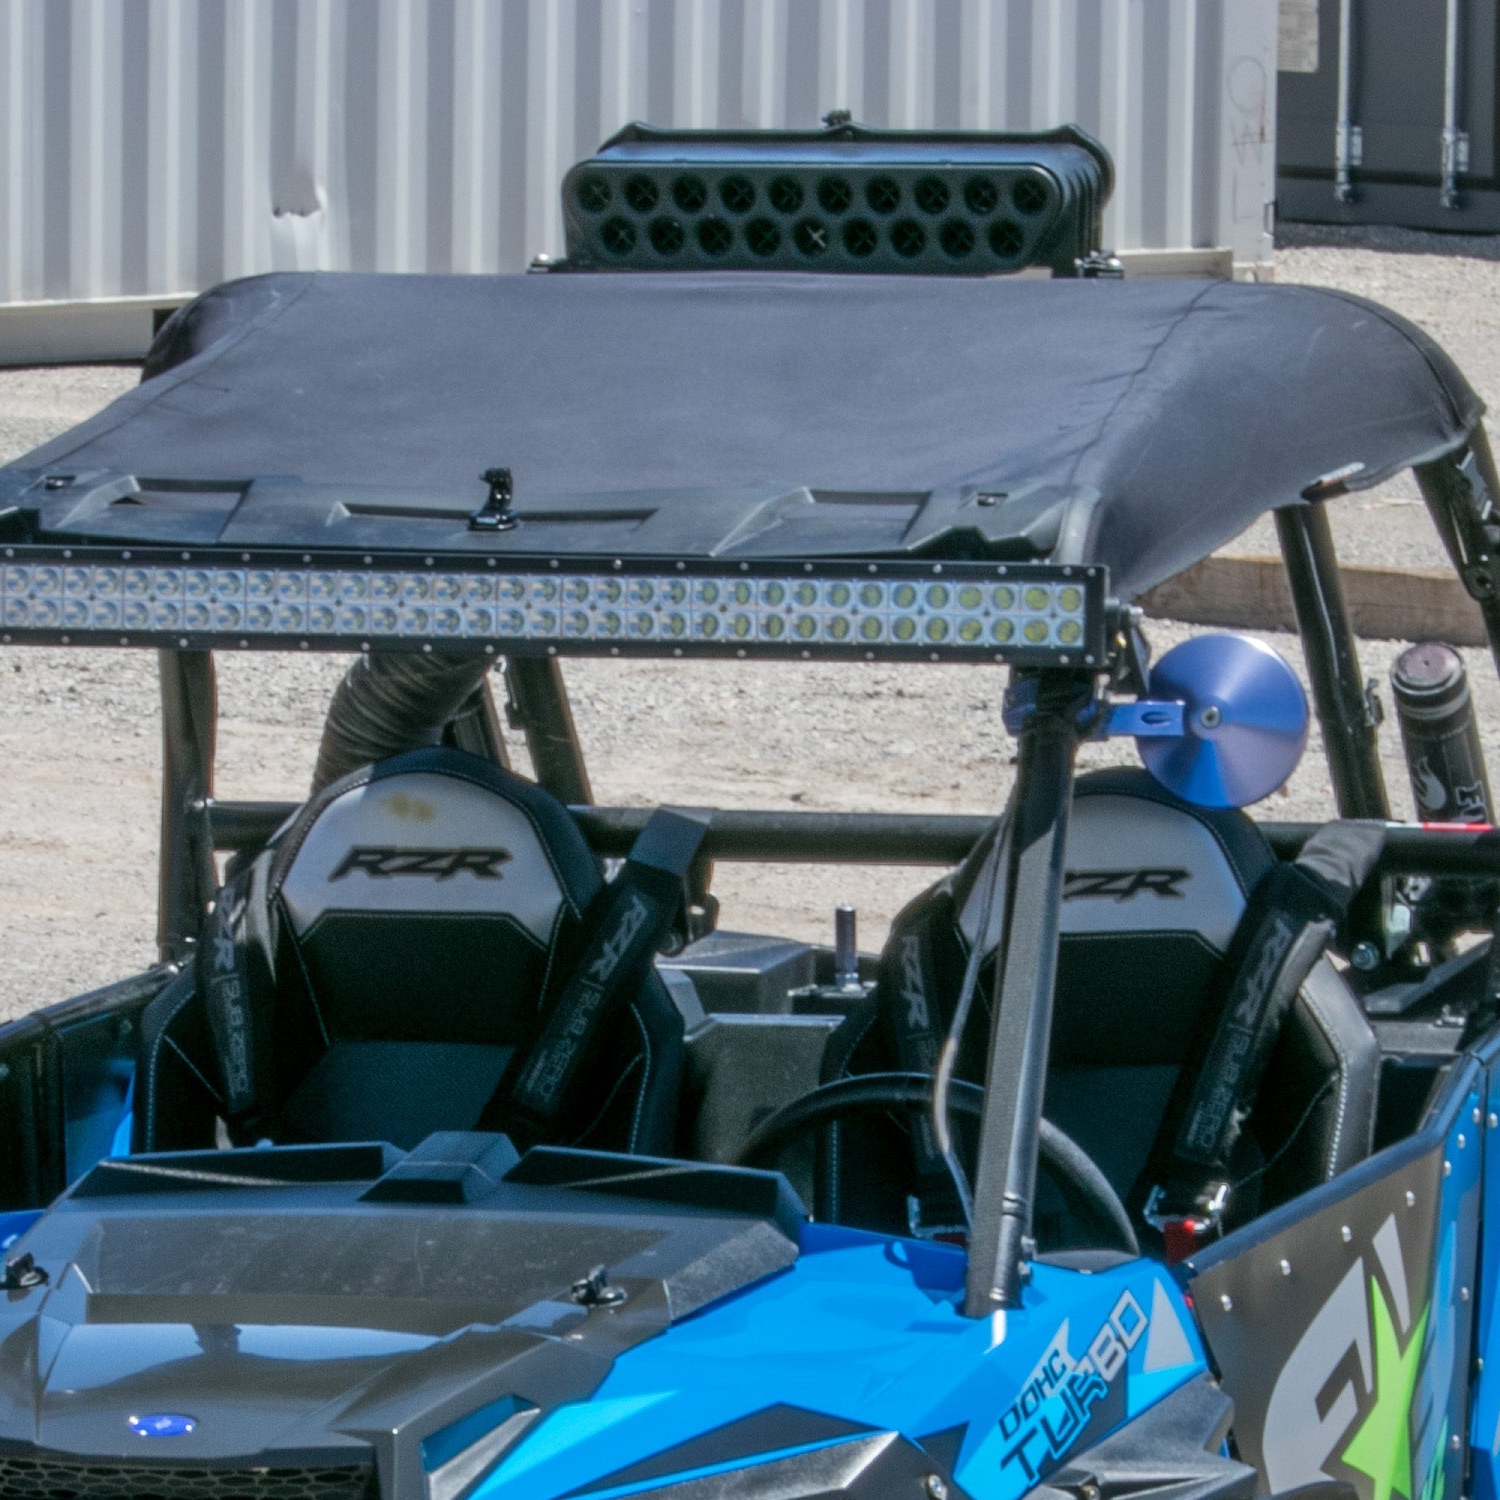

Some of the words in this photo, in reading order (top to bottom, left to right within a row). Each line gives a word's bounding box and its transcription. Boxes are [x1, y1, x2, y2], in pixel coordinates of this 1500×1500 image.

[327, 845, 514, 883] RZR
[1062, 866, 1194, 903] ZR
[998, 1349, 1068, 1441] DOHC
[1001, 1288, 1149, 1484] TURBO
